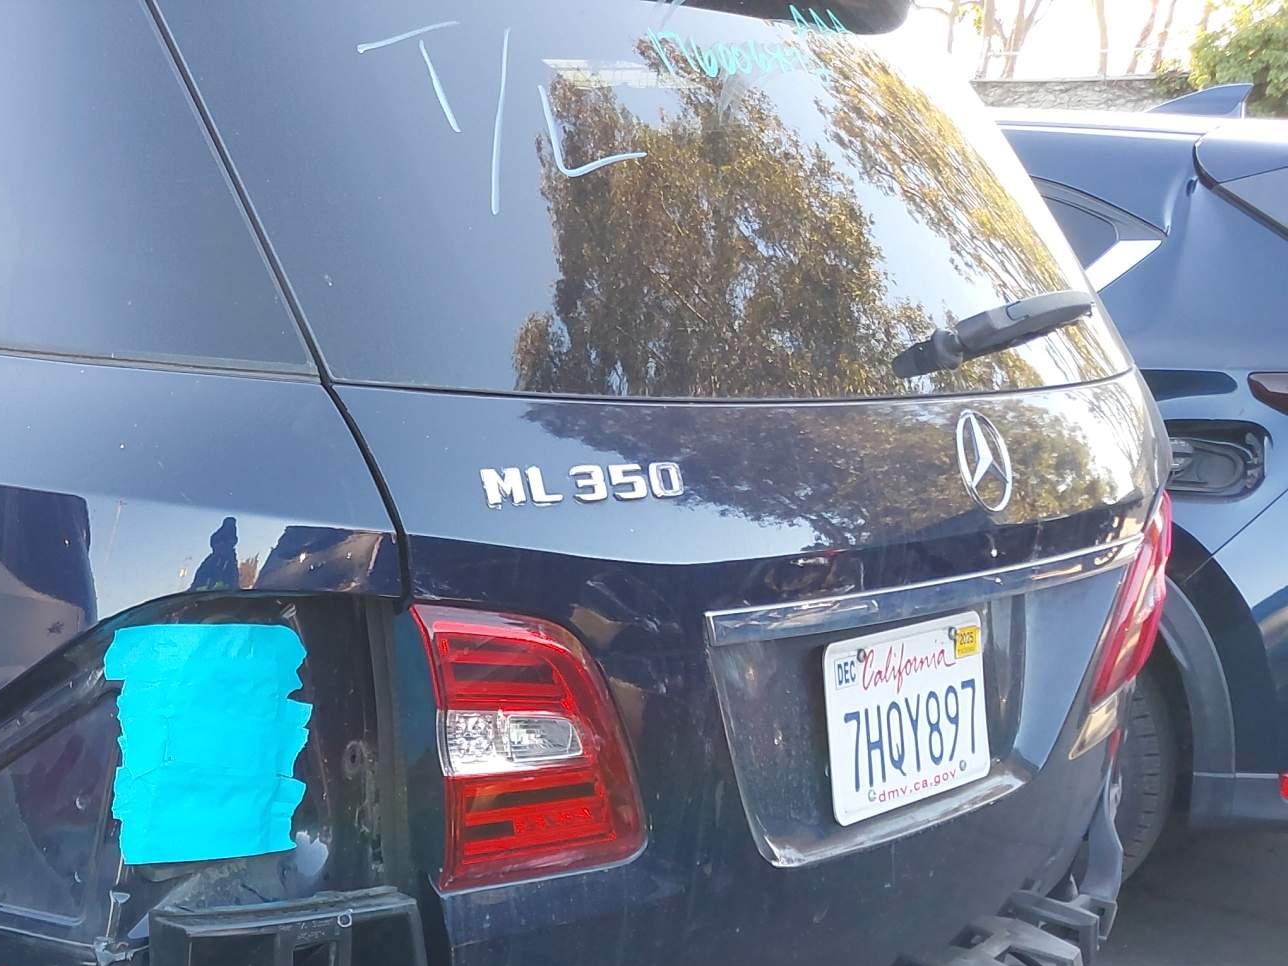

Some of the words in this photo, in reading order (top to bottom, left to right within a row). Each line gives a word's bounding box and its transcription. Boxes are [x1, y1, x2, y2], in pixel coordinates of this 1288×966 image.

[479, 465, 564, 508] ML
[568, 462, 685, 504] 350
[836, 660, 857, 687] DEC
[860, 642, 956, 694] California
[843, 678, 977, 793] 7HQY897
[878, 767, 958, 804] dmv.ca.gov
